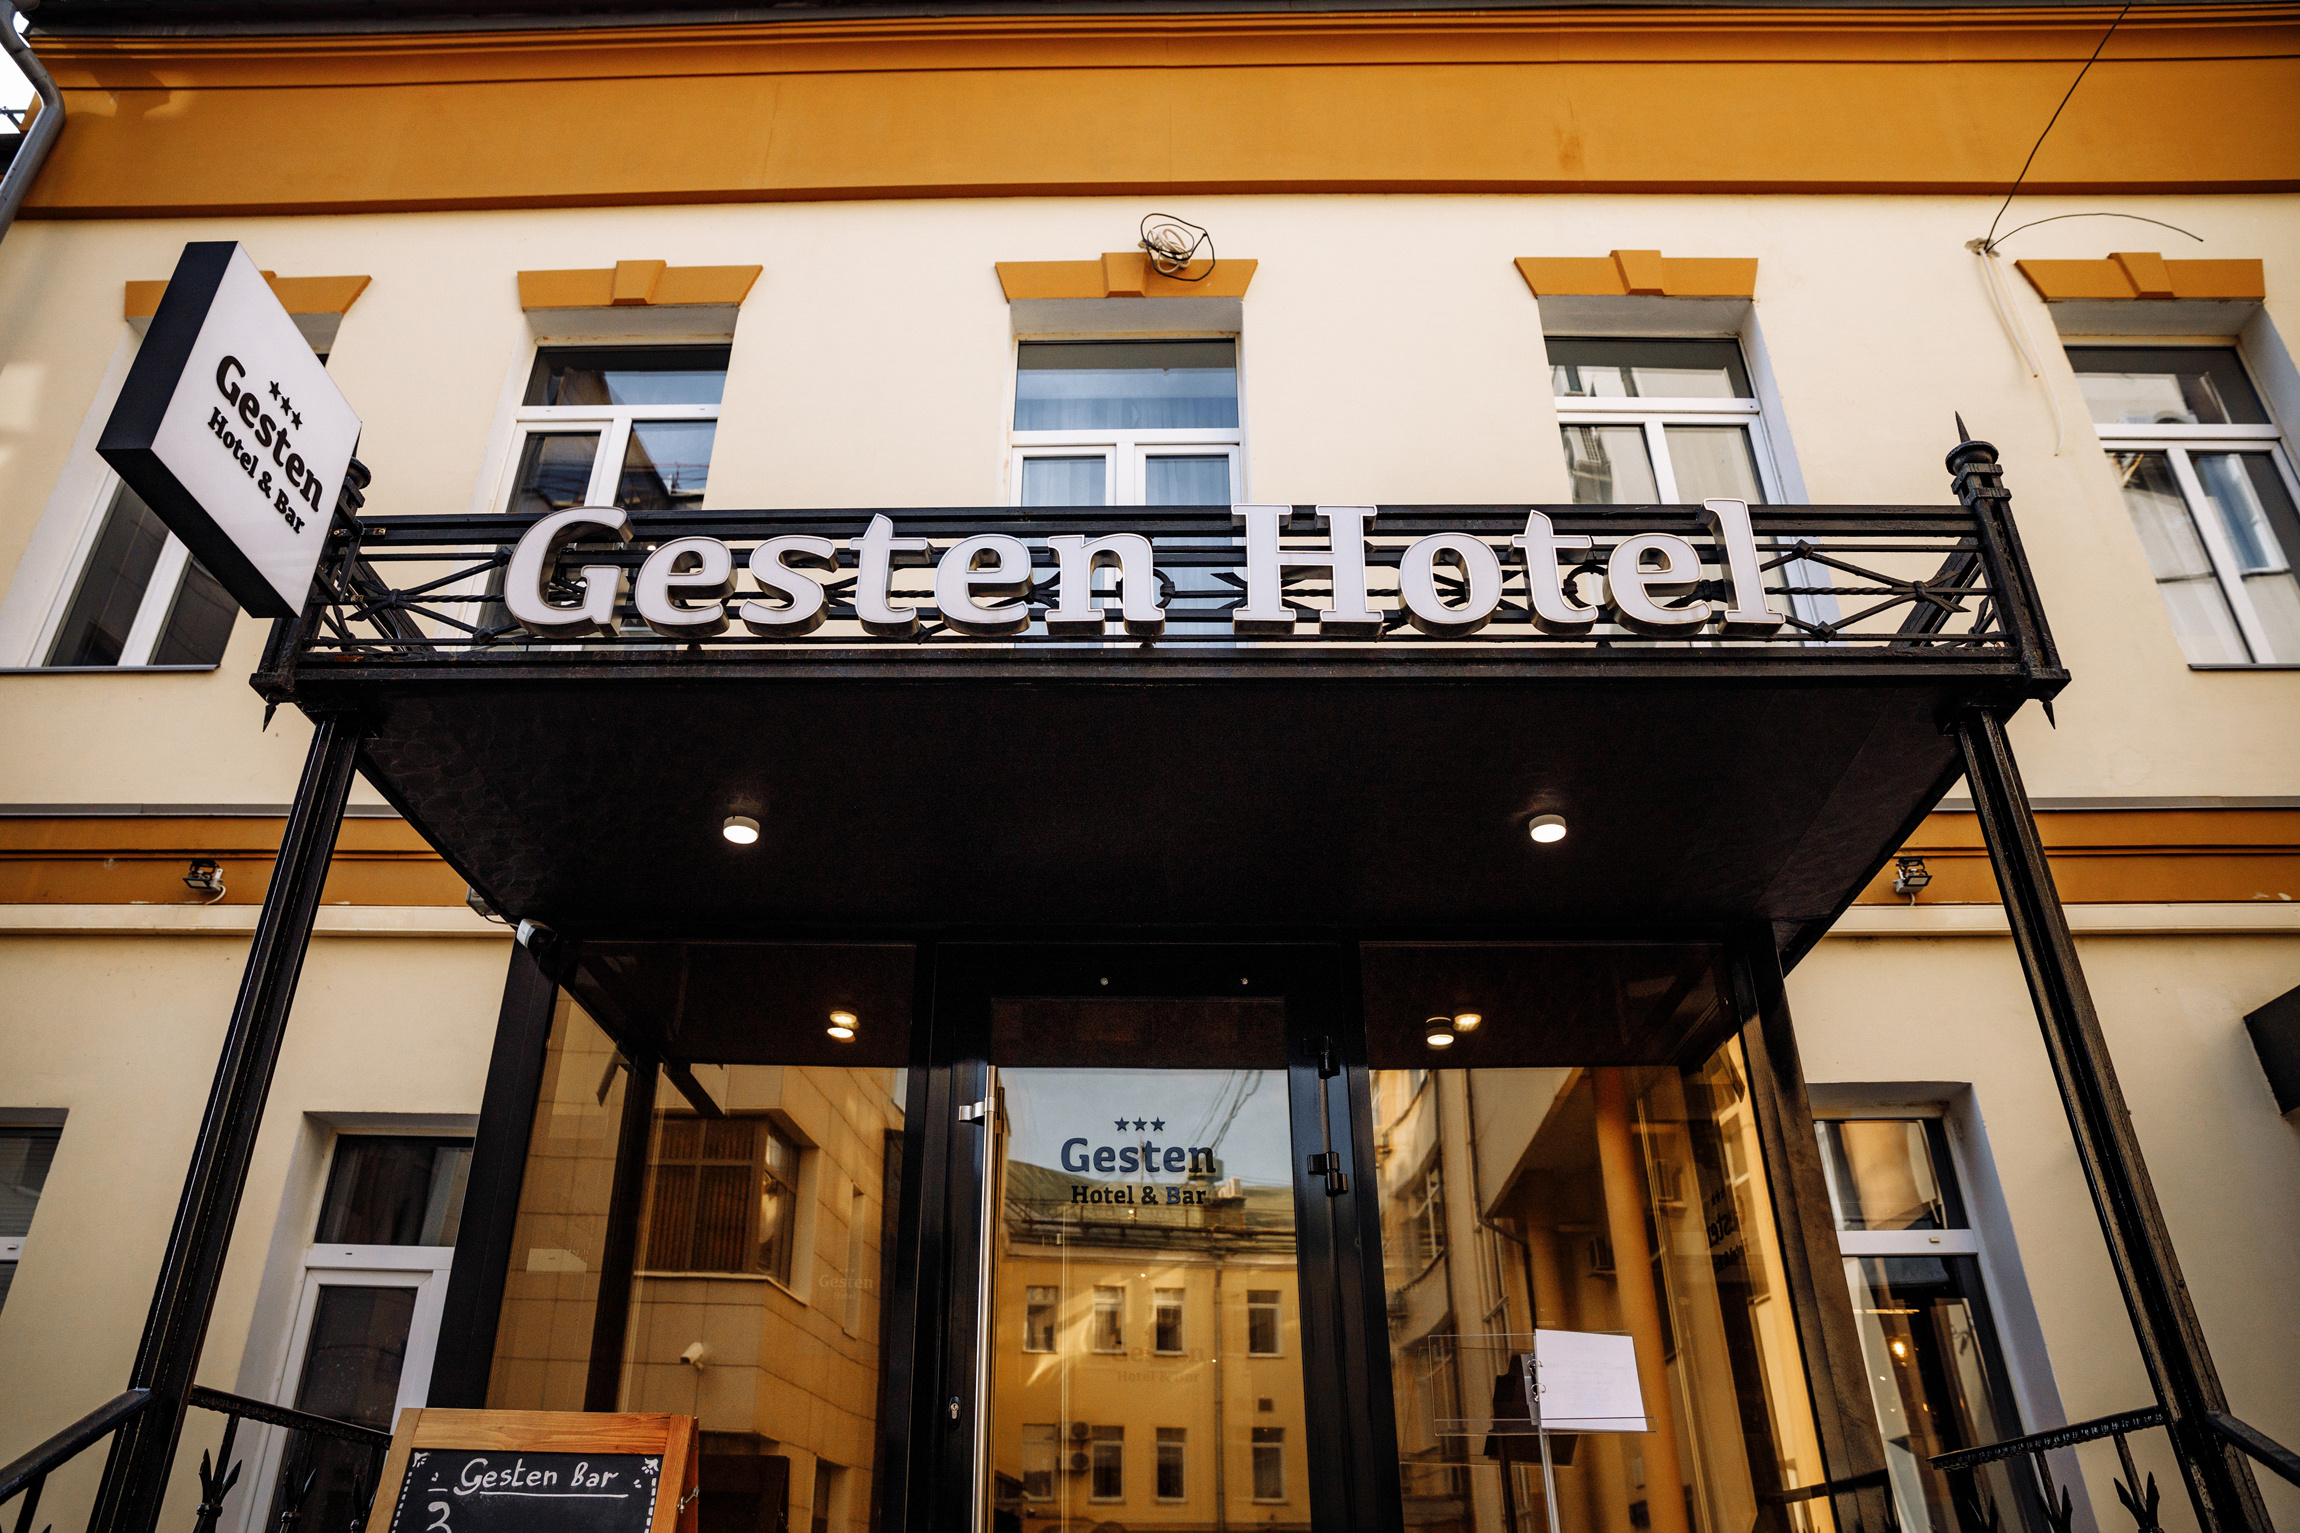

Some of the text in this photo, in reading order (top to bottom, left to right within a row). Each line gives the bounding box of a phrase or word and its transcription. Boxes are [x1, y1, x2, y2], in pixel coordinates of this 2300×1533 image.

[215, 355, 323, 513] Gesten
[207, 406, 305, 534] Hotel & Bar
[503, 498, 1786, 634] Gesten Hotel
[1060, 1137, 1216, 1173] Gesten
[1070, 1185, 1207, 1205] Hotel & Bar
[818, 1274, 873, 1289] Gesten
[834, 1292, 856, 1300] Hoel
[453, 1457, 619, 1496] Gesten Bar
